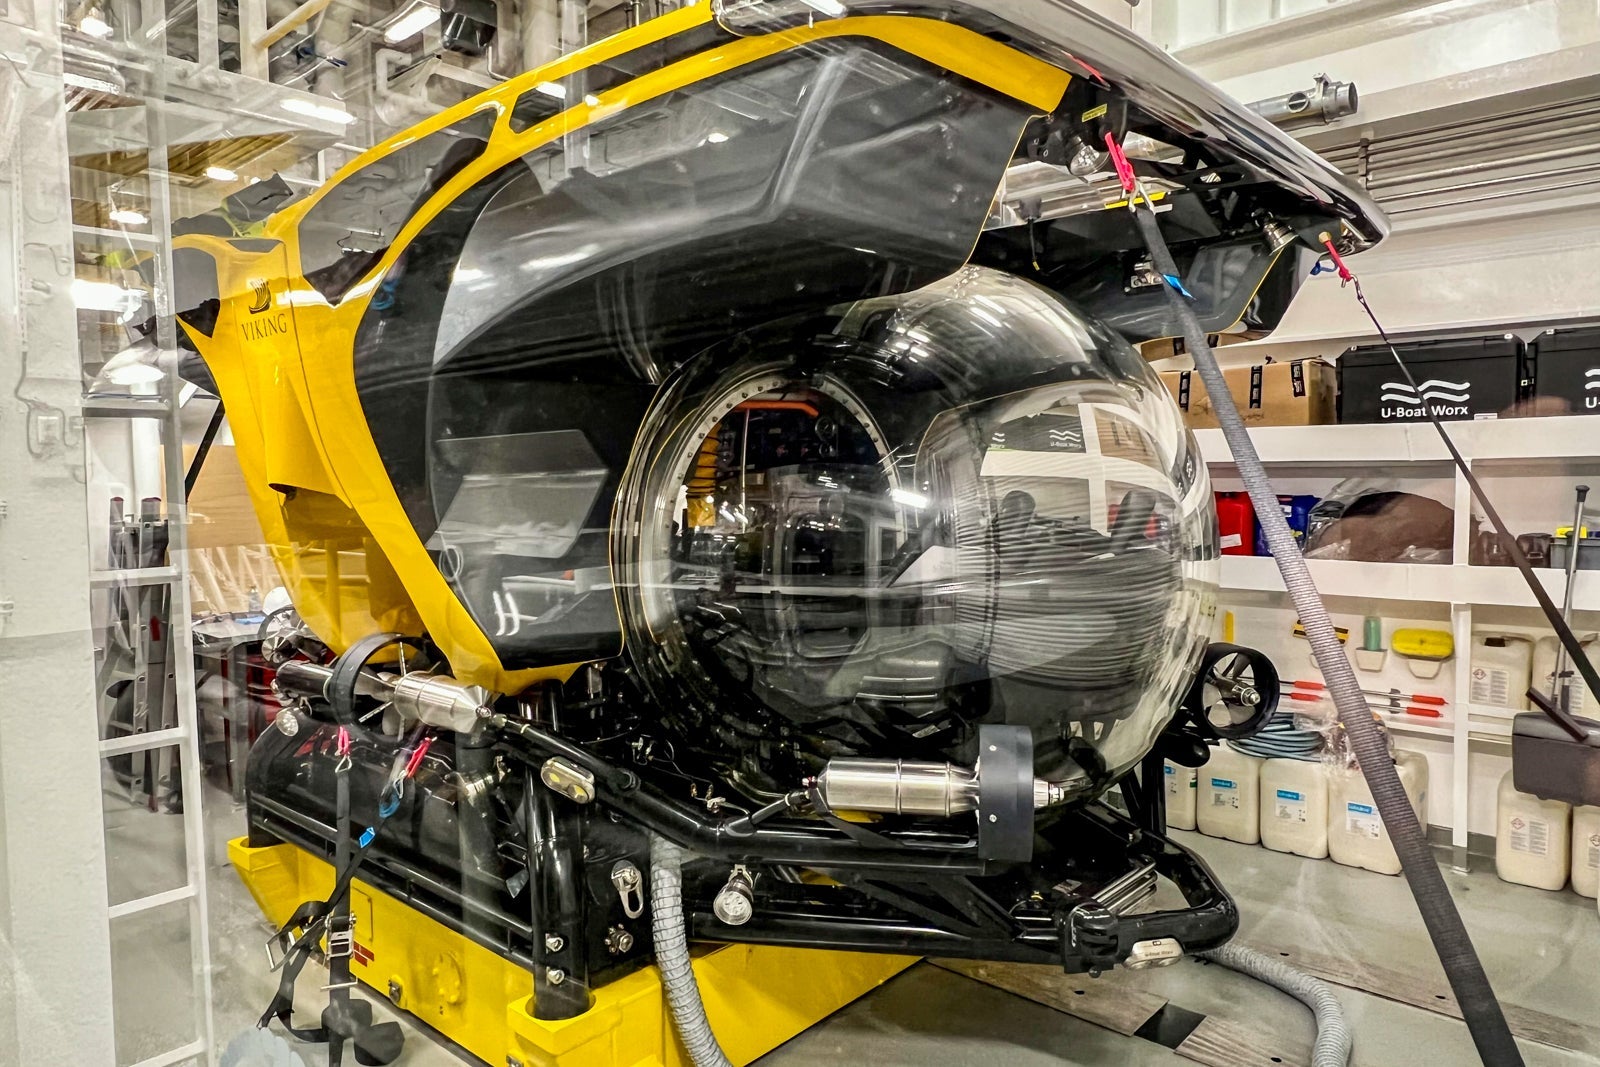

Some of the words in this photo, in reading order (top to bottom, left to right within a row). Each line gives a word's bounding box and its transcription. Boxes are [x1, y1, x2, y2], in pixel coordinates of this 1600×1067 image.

[241, 313, 287, 341] VIKING
[1381, 407, 1427, 418] U-Boat
[1431, 405, 1468, 416] Worx
